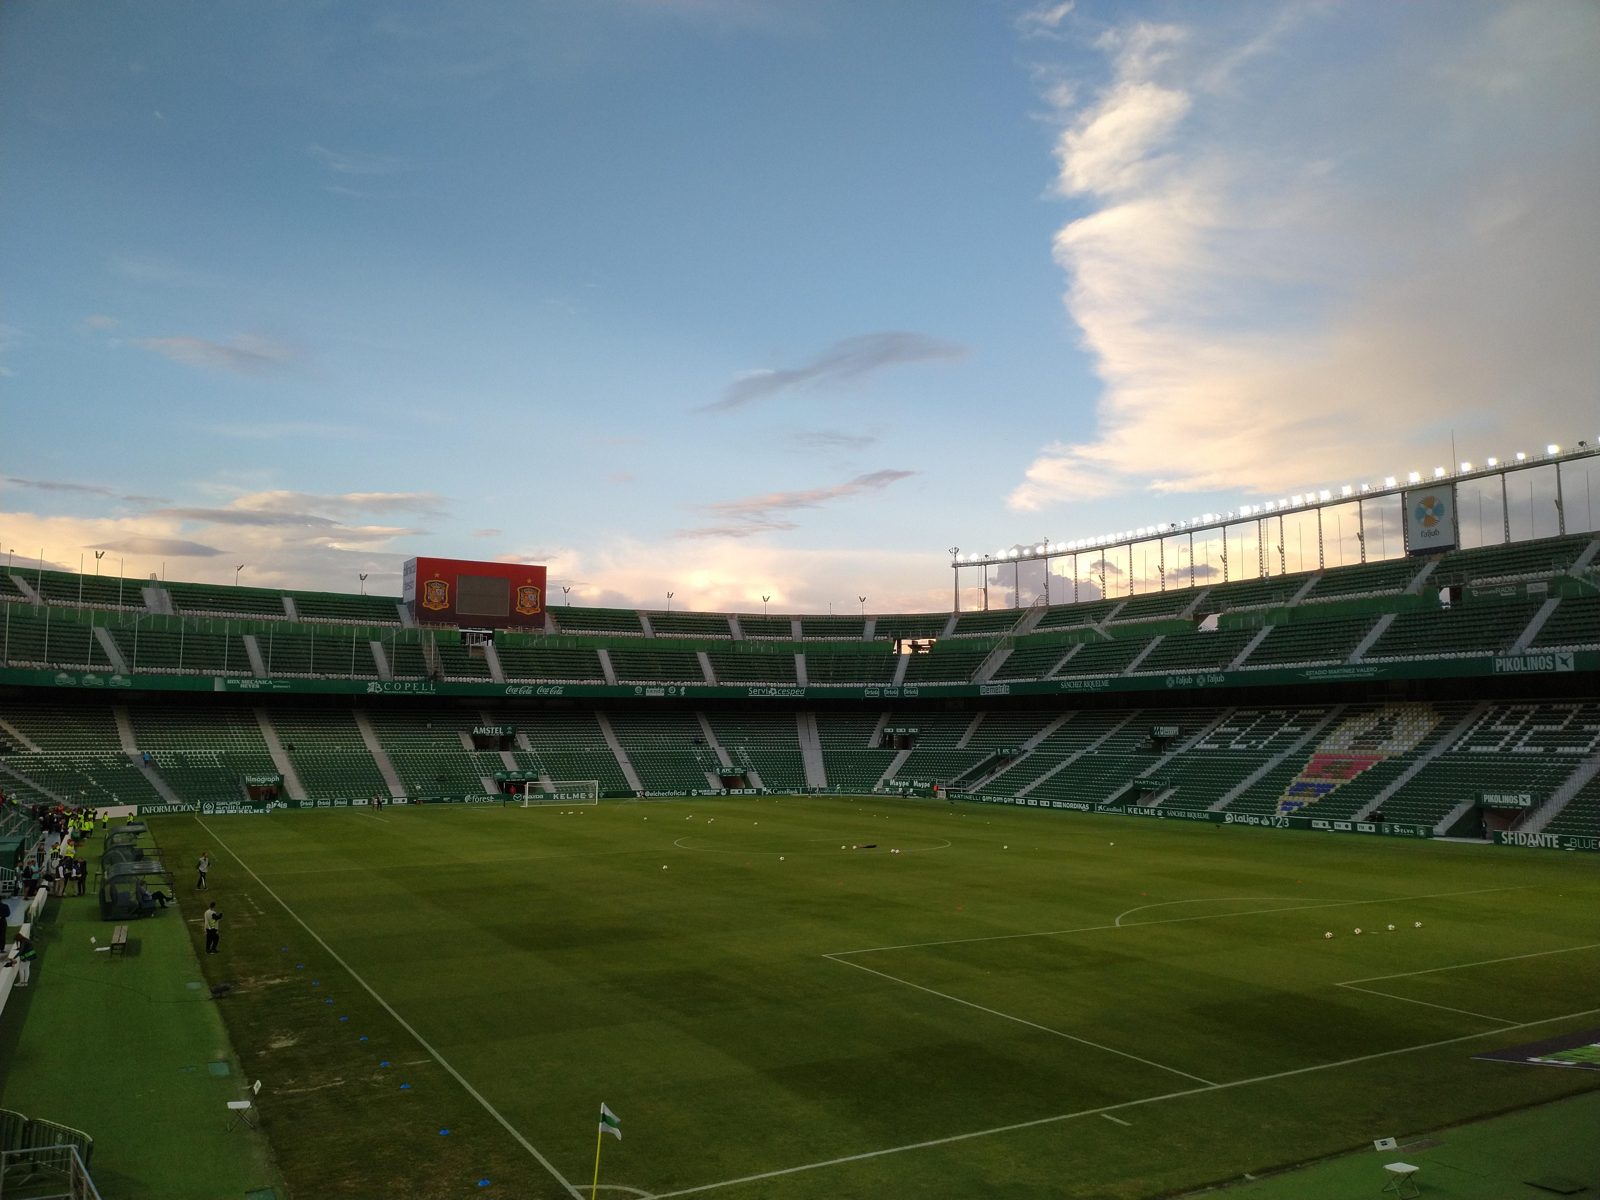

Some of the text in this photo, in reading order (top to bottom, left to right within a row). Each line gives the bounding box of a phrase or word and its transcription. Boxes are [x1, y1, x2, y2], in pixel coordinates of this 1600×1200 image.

[1495, 655, 1554, 672] PIKOLINOS
[383, 682, 437, 691] COPELL
[472, 726, 504, 735] AMSTEL
[1483, 794, 1519, 805] PIKOLINOS
[142, 804, 195, 814] INFORMACIÓN
[1127, 807, 1156, 816] KELME
[1501, 831, 1560, 849] SFIDANTE
